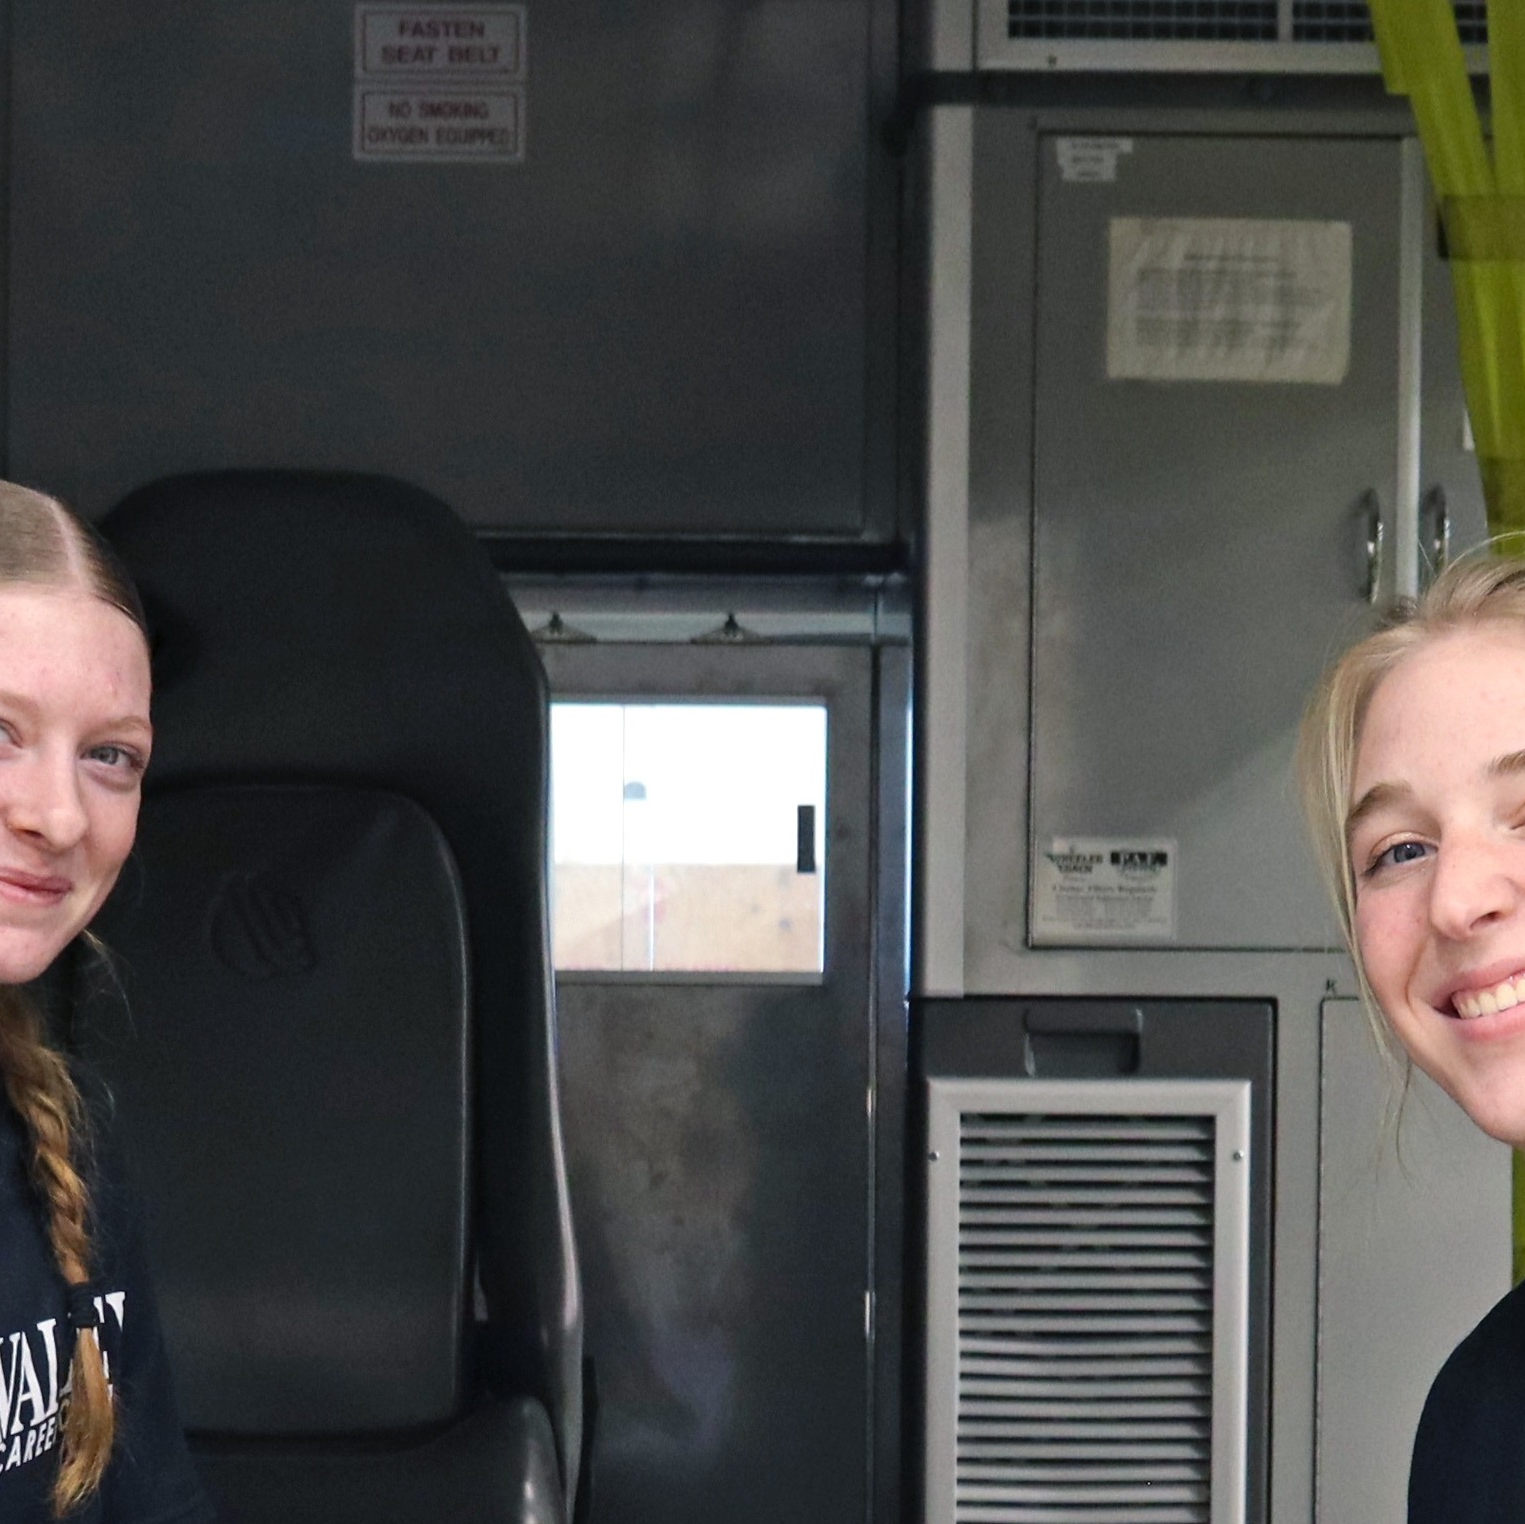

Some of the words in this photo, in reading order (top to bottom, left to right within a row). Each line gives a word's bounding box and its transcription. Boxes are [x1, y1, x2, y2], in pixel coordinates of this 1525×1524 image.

[399, 21, 485, 38] FASTEN
[381, 46, 434, 64] SEAT
[449, 45, 499, 64] BELT
[388, 102, 412, 119] NO
[419, 101, 490, 119] SMOKING
[368, 127, 428, 145] OXYGEN
